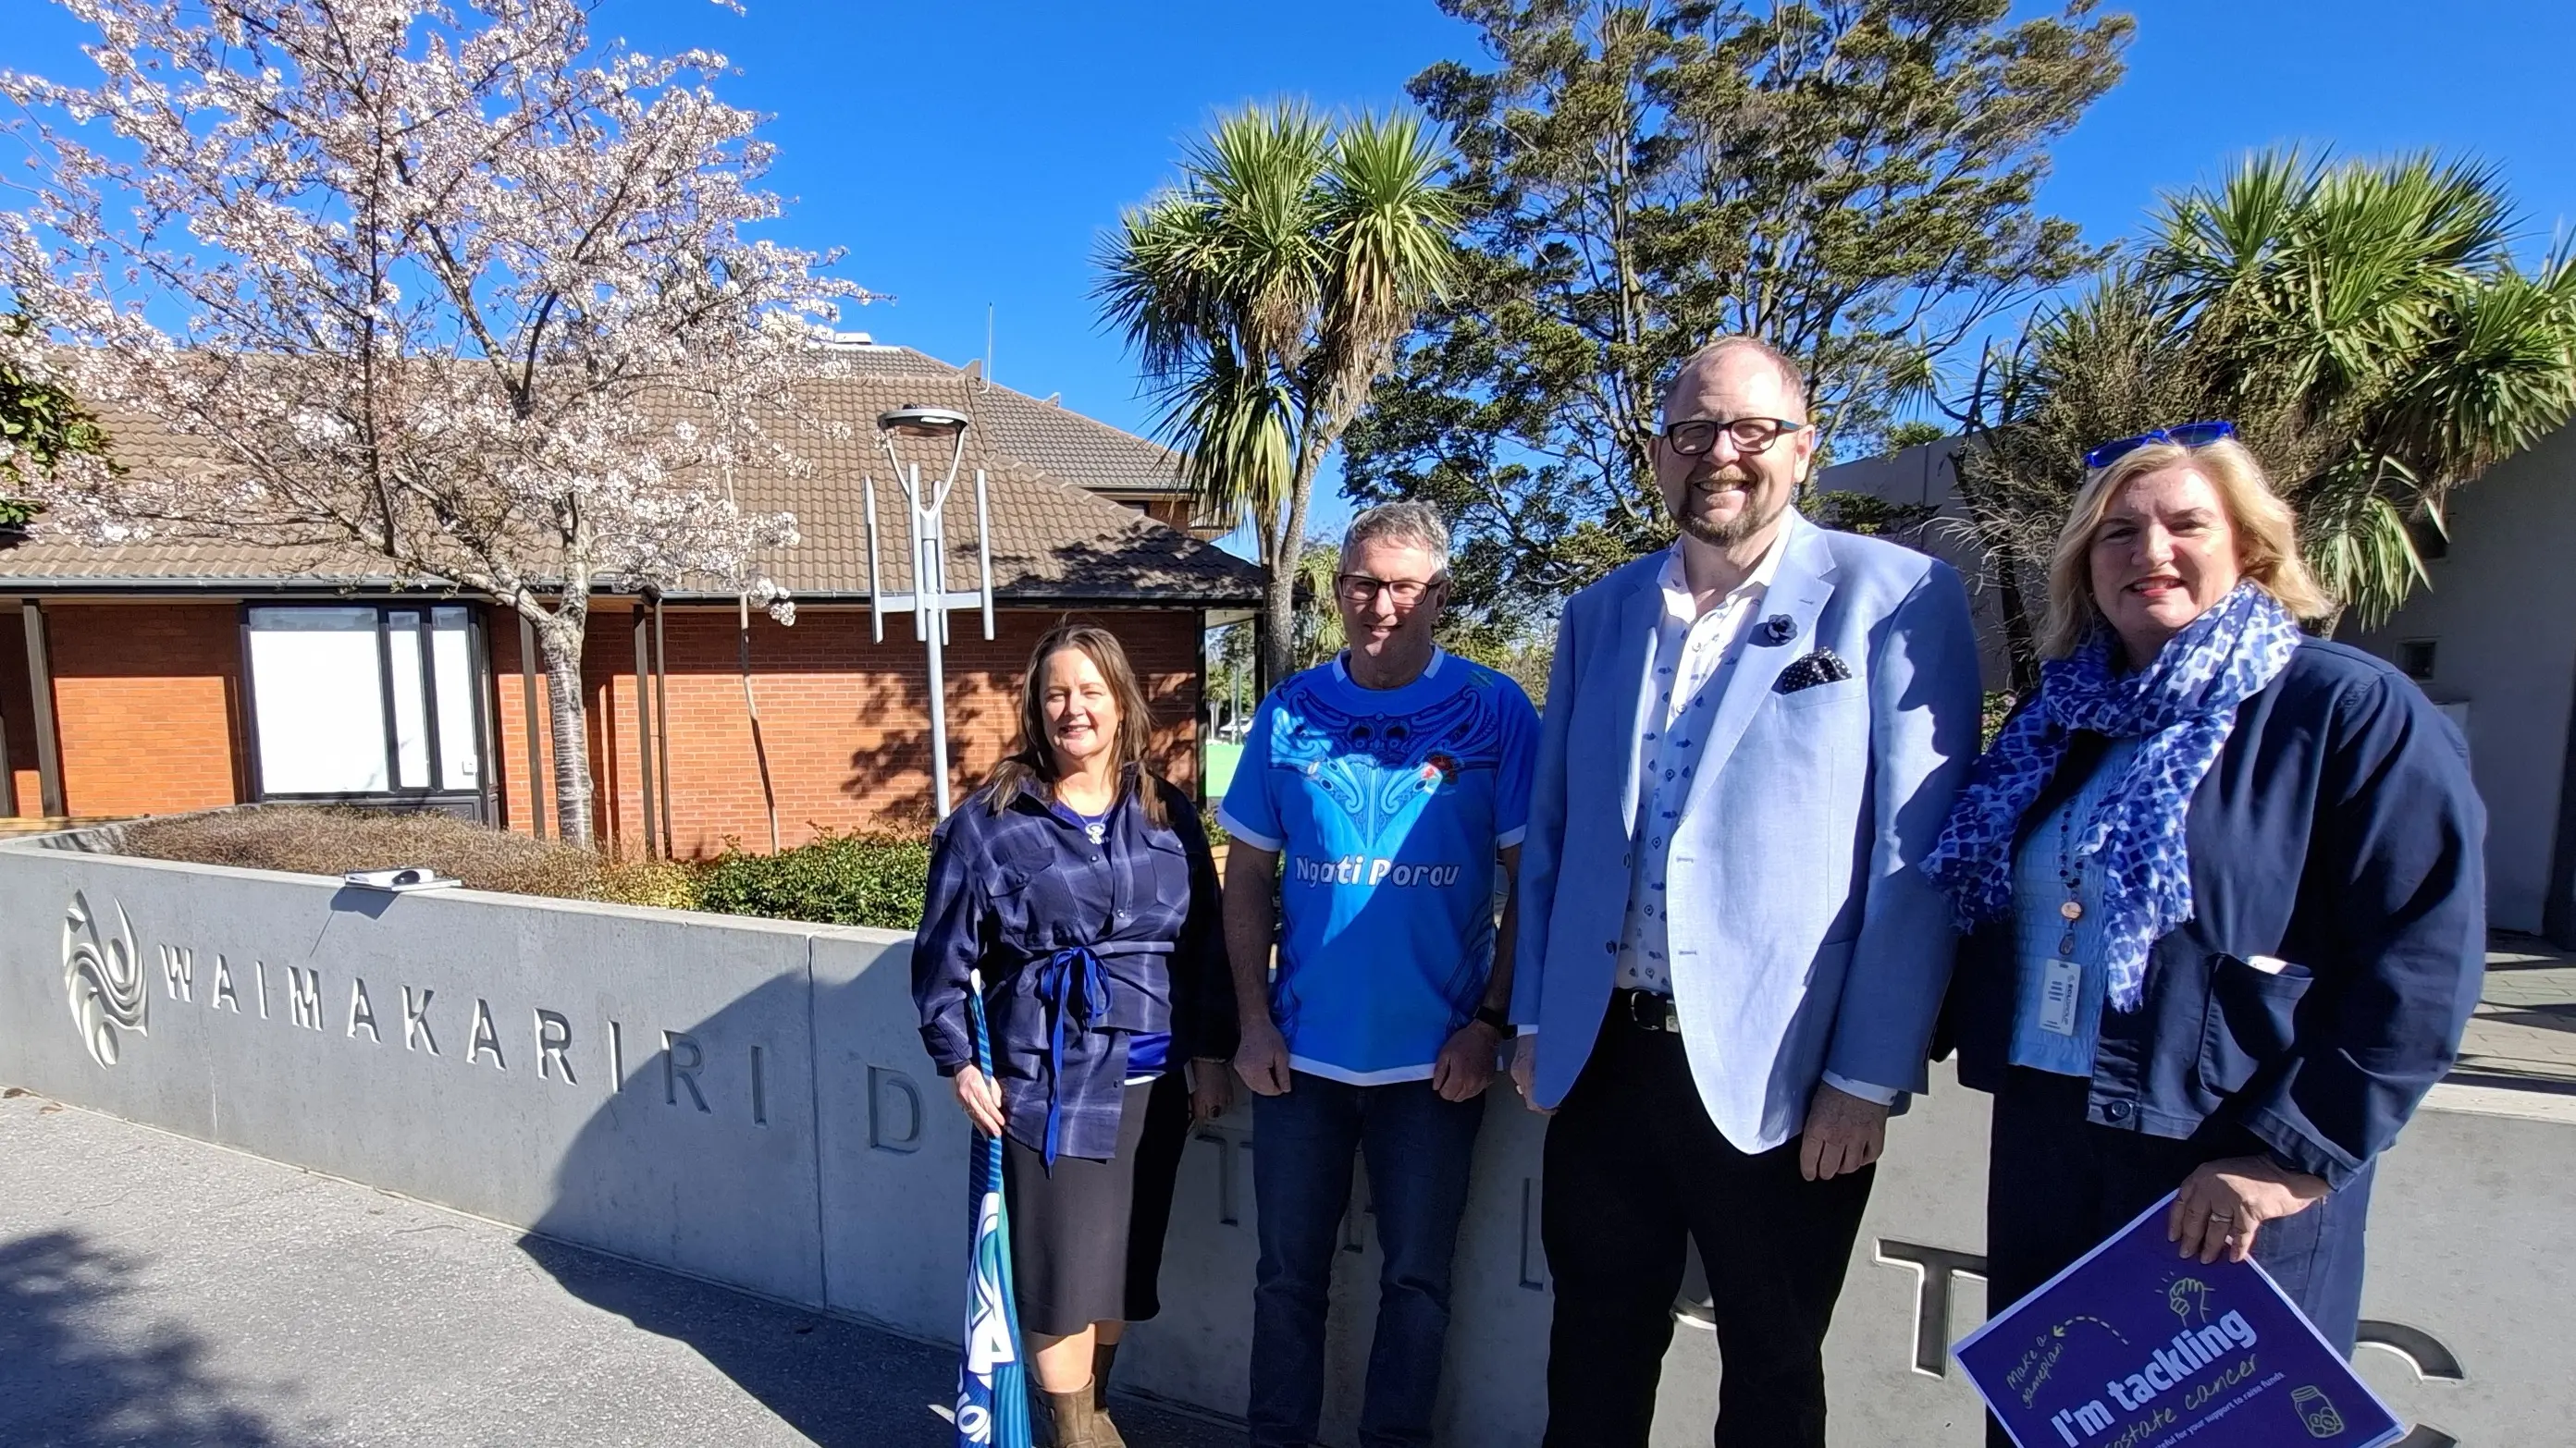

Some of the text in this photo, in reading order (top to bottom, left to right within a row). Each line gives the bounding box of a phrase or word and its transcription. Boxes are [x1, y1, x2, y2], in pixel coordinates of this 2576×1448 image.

[1295, 855, 1460, 888] Ngati Porou
[159, 943, 770, 1127] WAIMAKARIRI
[2006, 1334, 2047, 1390] Make a
[2022, 1343, 2064, 1410] gameplan
[2051, 1308, 2258, 1448] I'm tackling
[2185, 1353, 2257, 1410] cancer
[2176, 1429, 2188, 1441] for
[2186, 1419, 2206, 1435] your
[2204, 1402, 2236, 1423] support
[2233, 1396, 2245, 1406] to
[2243, 1385, 2263, 1401] raise
